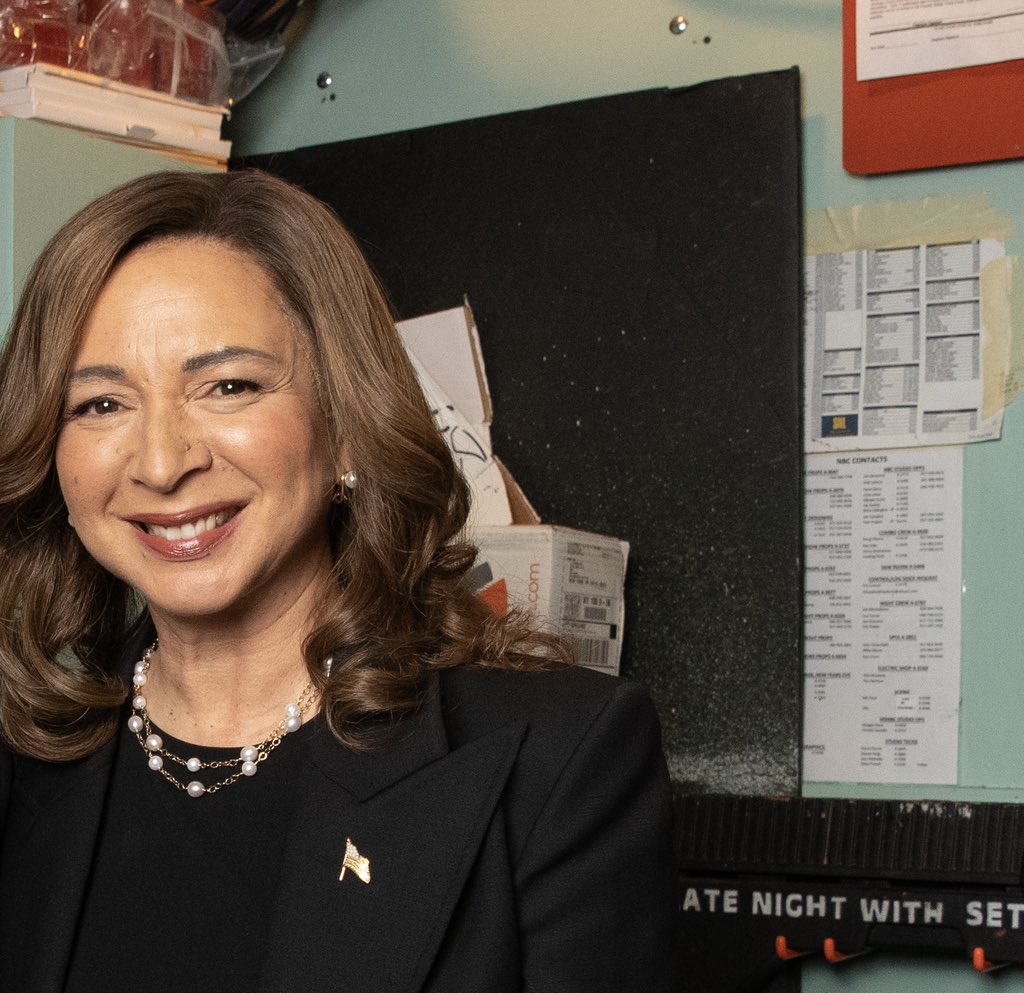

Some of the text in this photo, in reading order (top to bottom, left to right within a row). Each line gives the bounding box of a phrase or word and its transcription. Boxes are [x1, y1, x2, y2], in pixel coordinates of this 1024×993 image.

[852, 456, 888, 464] CONTACTS
[752, 891, 846, 919] NIGHT
[860, 898, 943, 923] WITH
[966, 901, 1024, 929] SET
